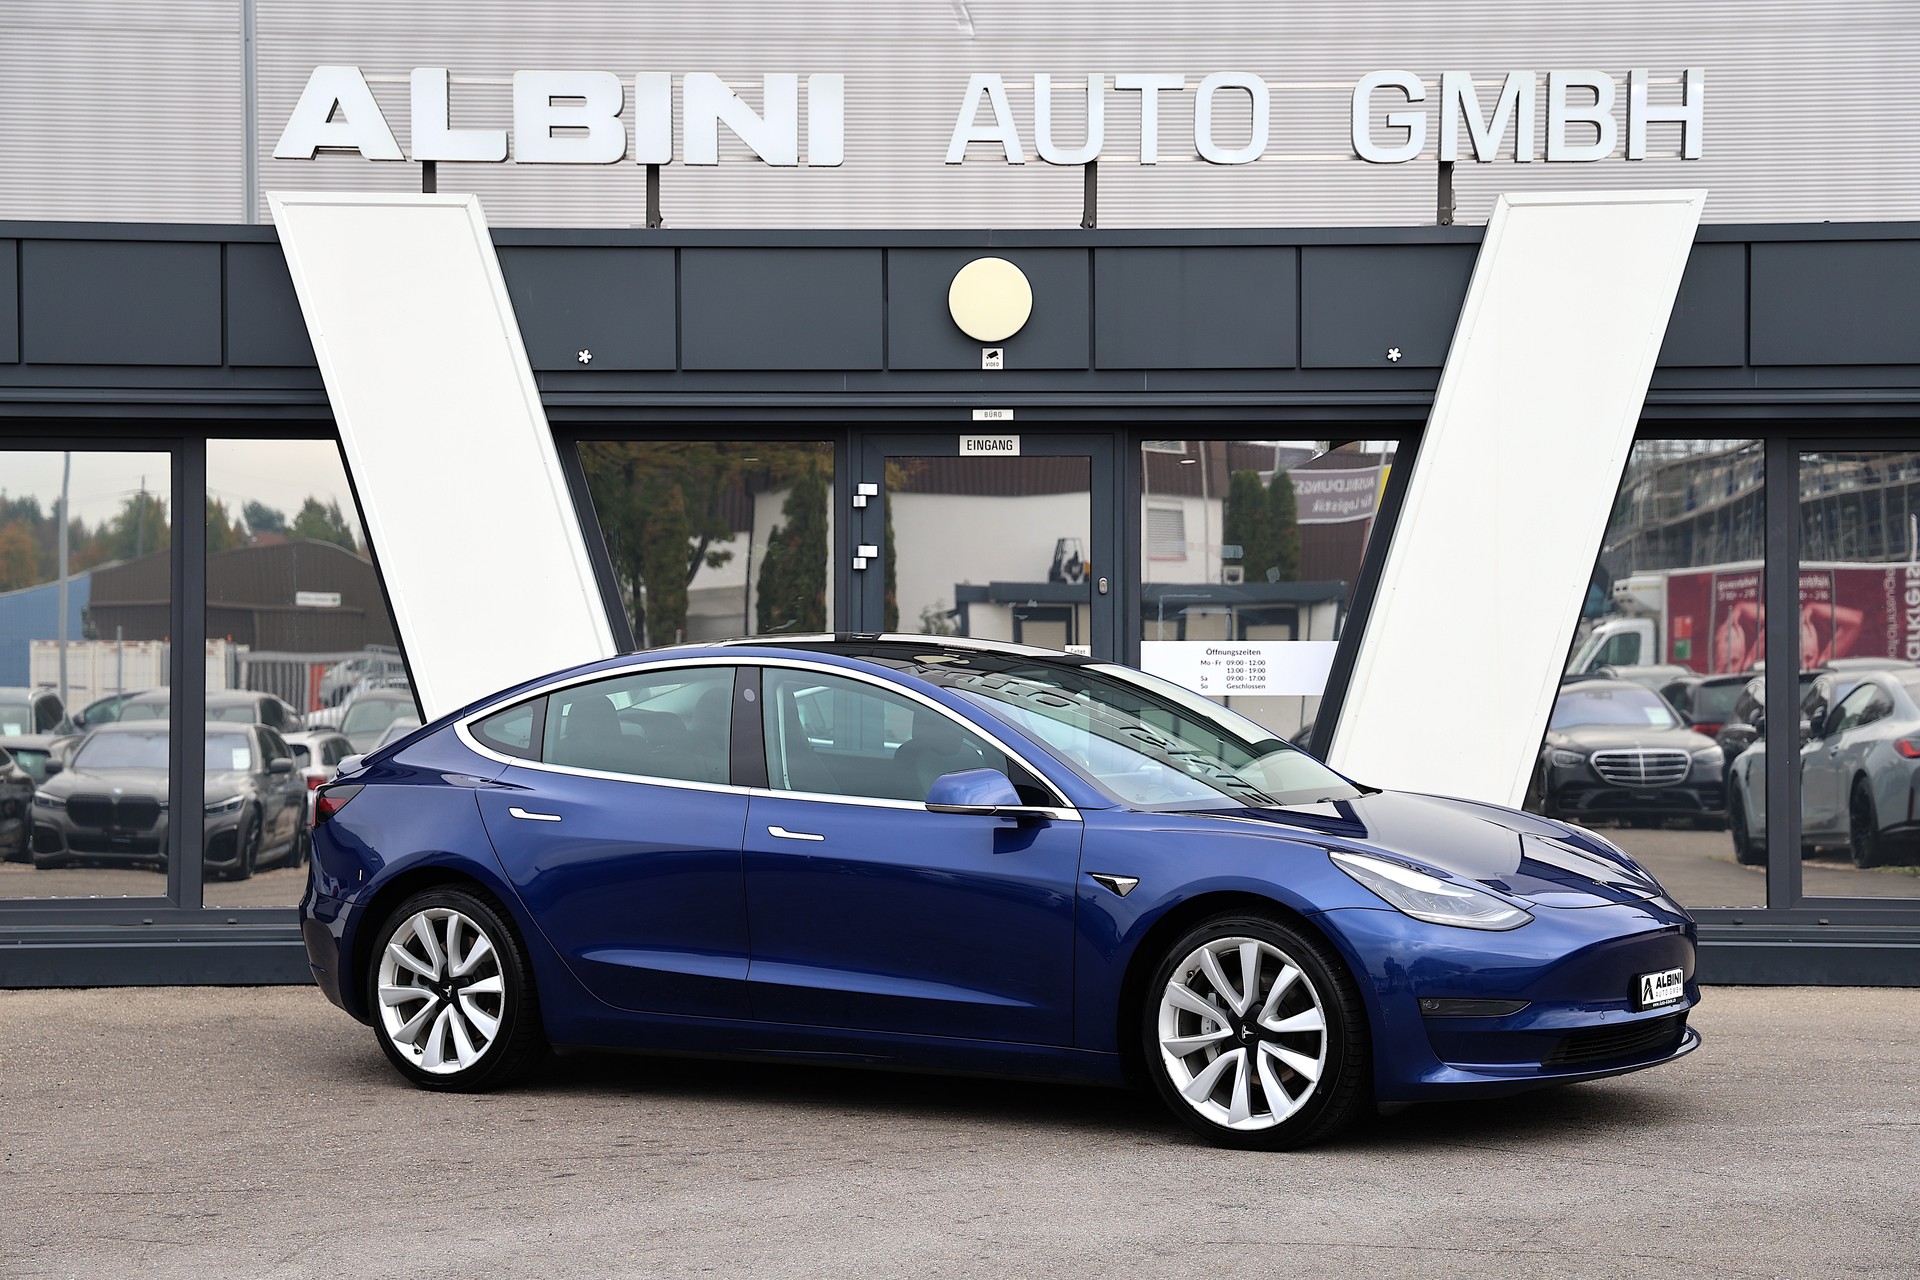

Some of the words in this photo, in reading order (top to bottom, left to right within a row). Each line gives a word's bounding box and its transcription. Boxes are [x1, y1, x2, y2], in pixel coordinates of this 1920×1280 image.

[273, 65, 845, 167] ALBINI
[945, 70, 1270, 165] AUTO
[1351, 67, 1706, 165] GMBH
[984, 410, 1003, 418] BÜRO
[966, 439, 1013, 451] EINGANG
[1205, 647, 1261, 657] Öffnungszeiten
[1656, 972, 1682, 989] ALBINI
